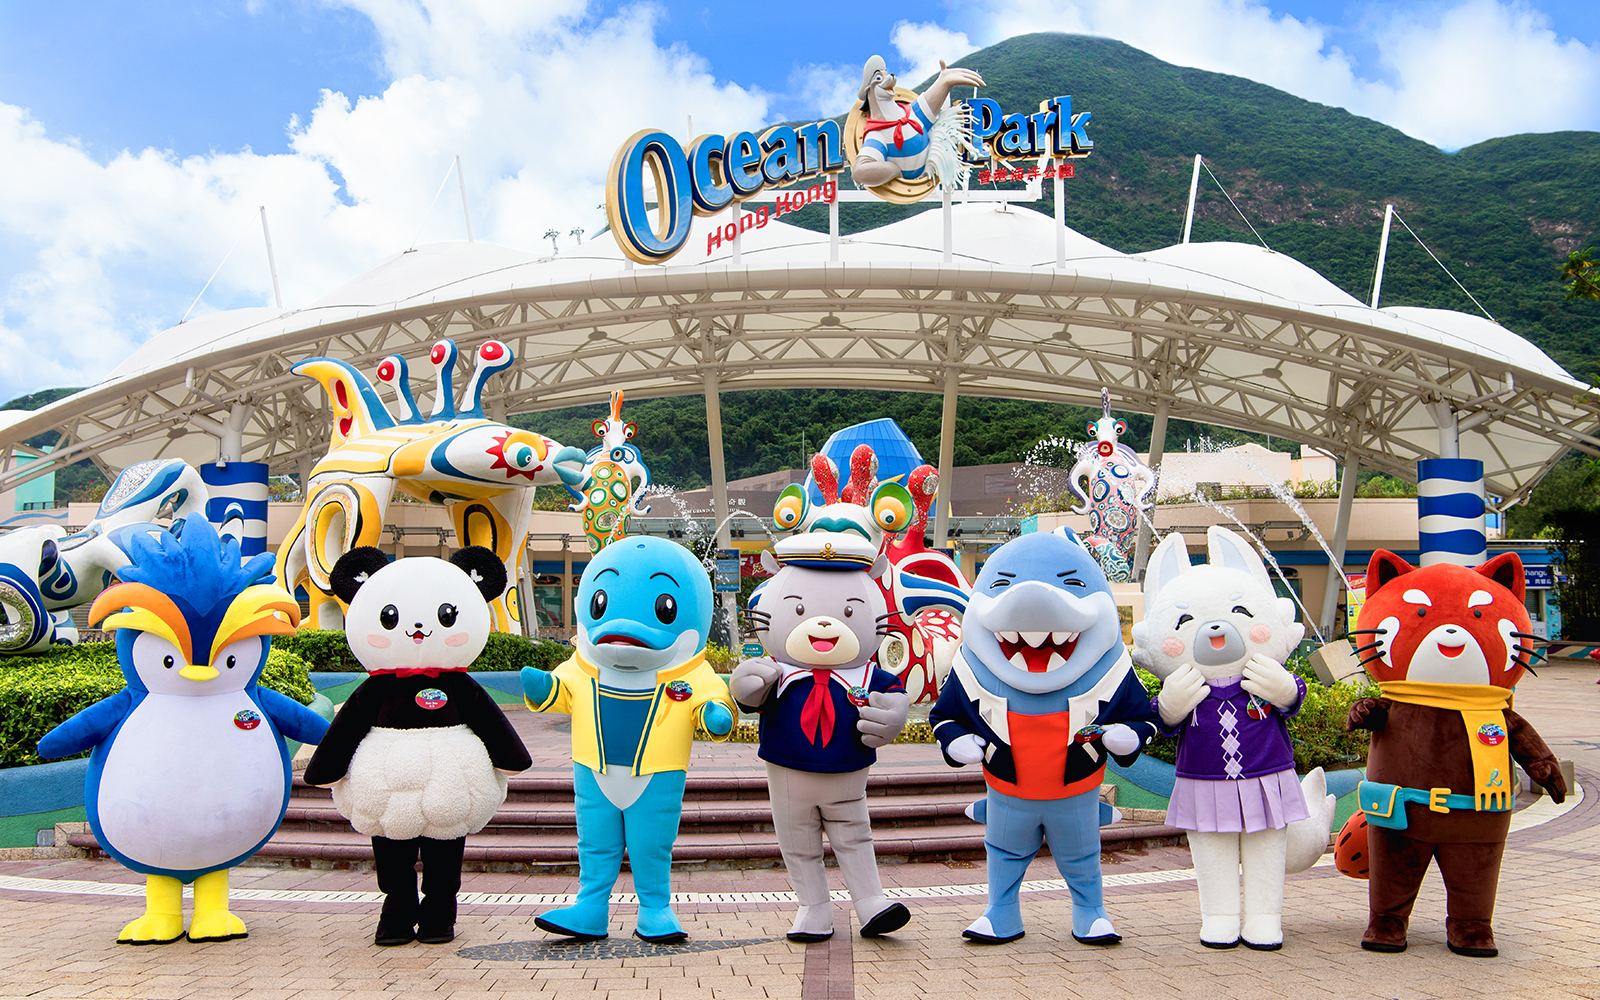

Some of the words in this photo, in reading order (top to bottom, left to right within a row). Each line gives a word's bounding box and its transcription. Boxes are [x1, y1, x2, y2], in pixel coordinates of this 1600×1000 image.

[607, 120, 844, 263] Ocean
[964, 95, 1094, 160] Park
[978, 164, 1074, 185] 香港海洋公園
[707, 205, 769, 256] Hong
[776, 180, 836, 218] Kong
